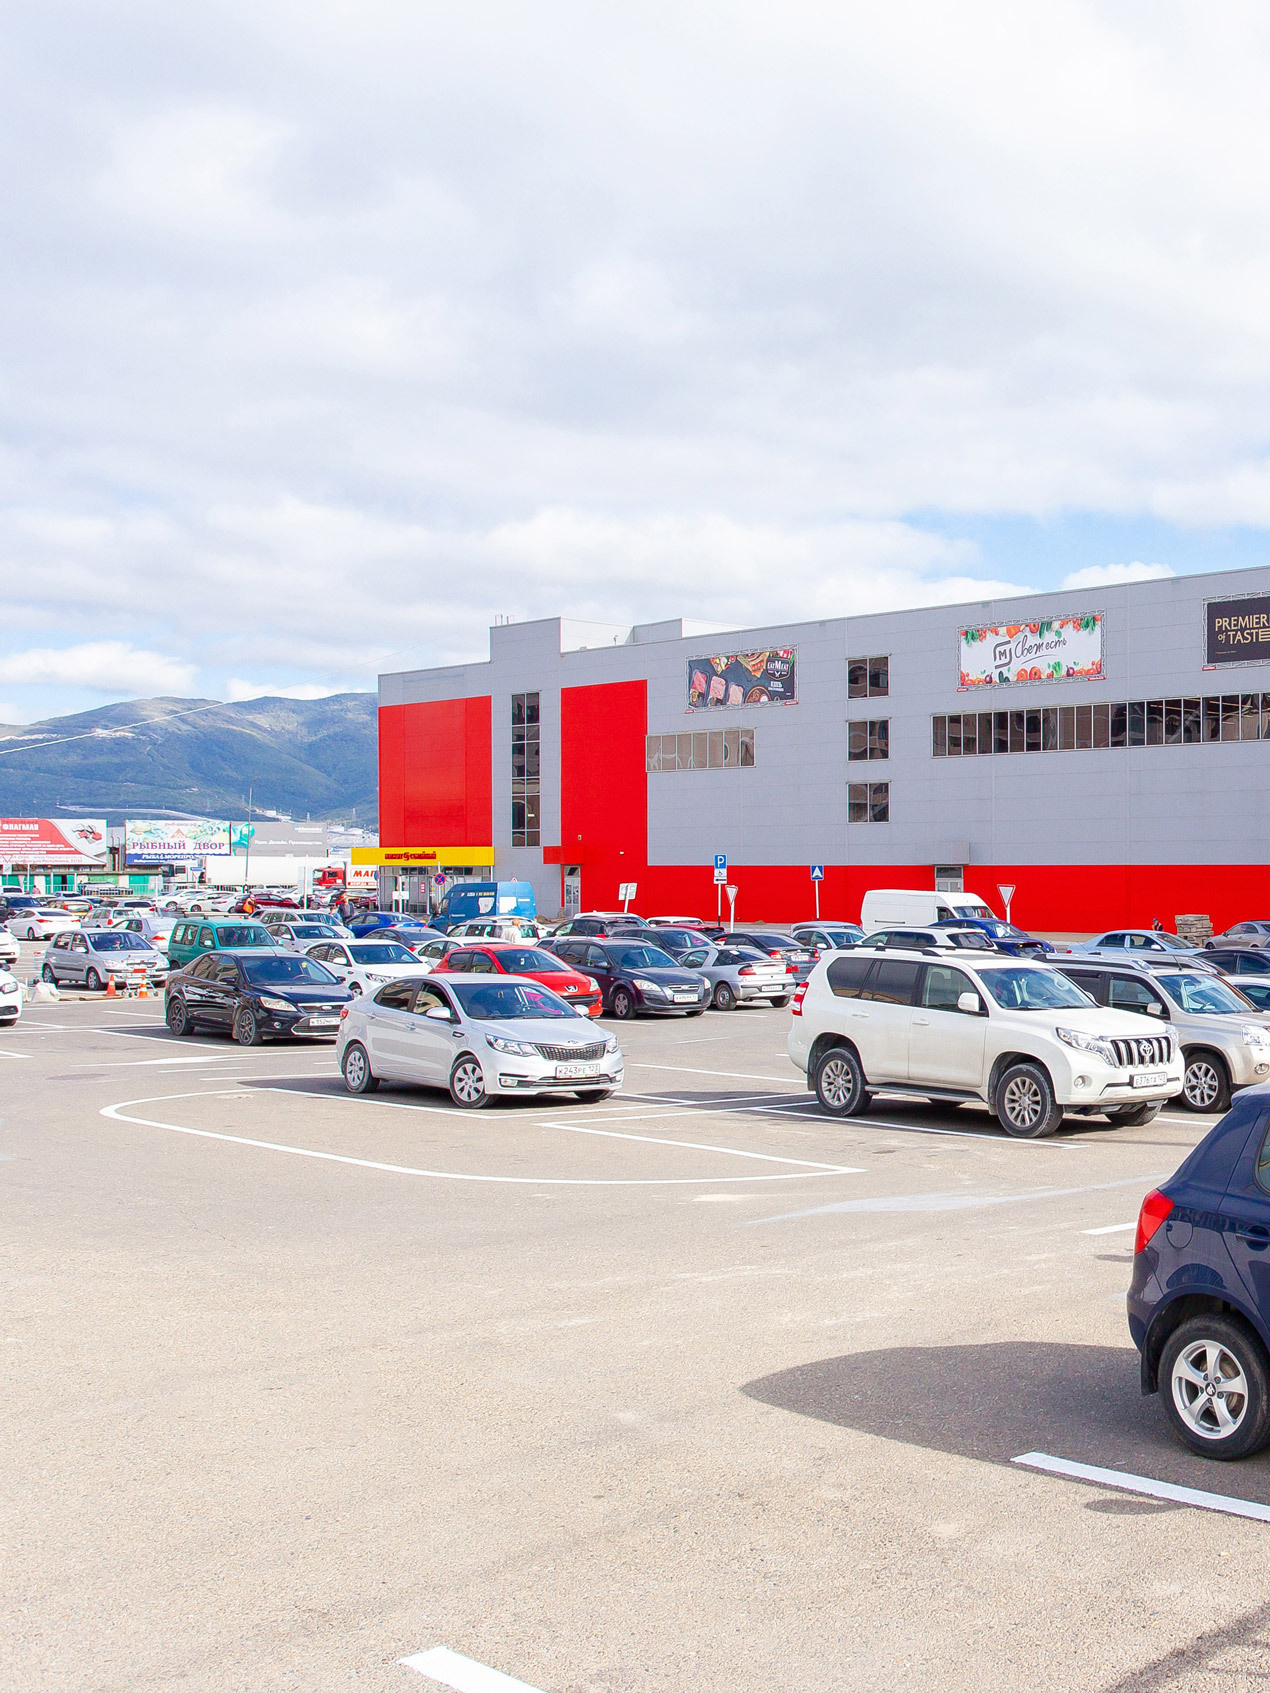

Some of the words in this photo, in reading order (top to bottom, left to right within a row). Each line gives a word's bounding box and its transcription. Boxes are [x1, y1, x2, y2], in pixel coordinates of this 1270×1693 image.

[1217, 632, 1227, 644] of
[1014, 634, 1068, 659] Свежесть
[132, 840, 187, 850] РЫБНЫЙ
[193, 842, 225, 851] ДВОР
[717, 856, 725, 867] P
